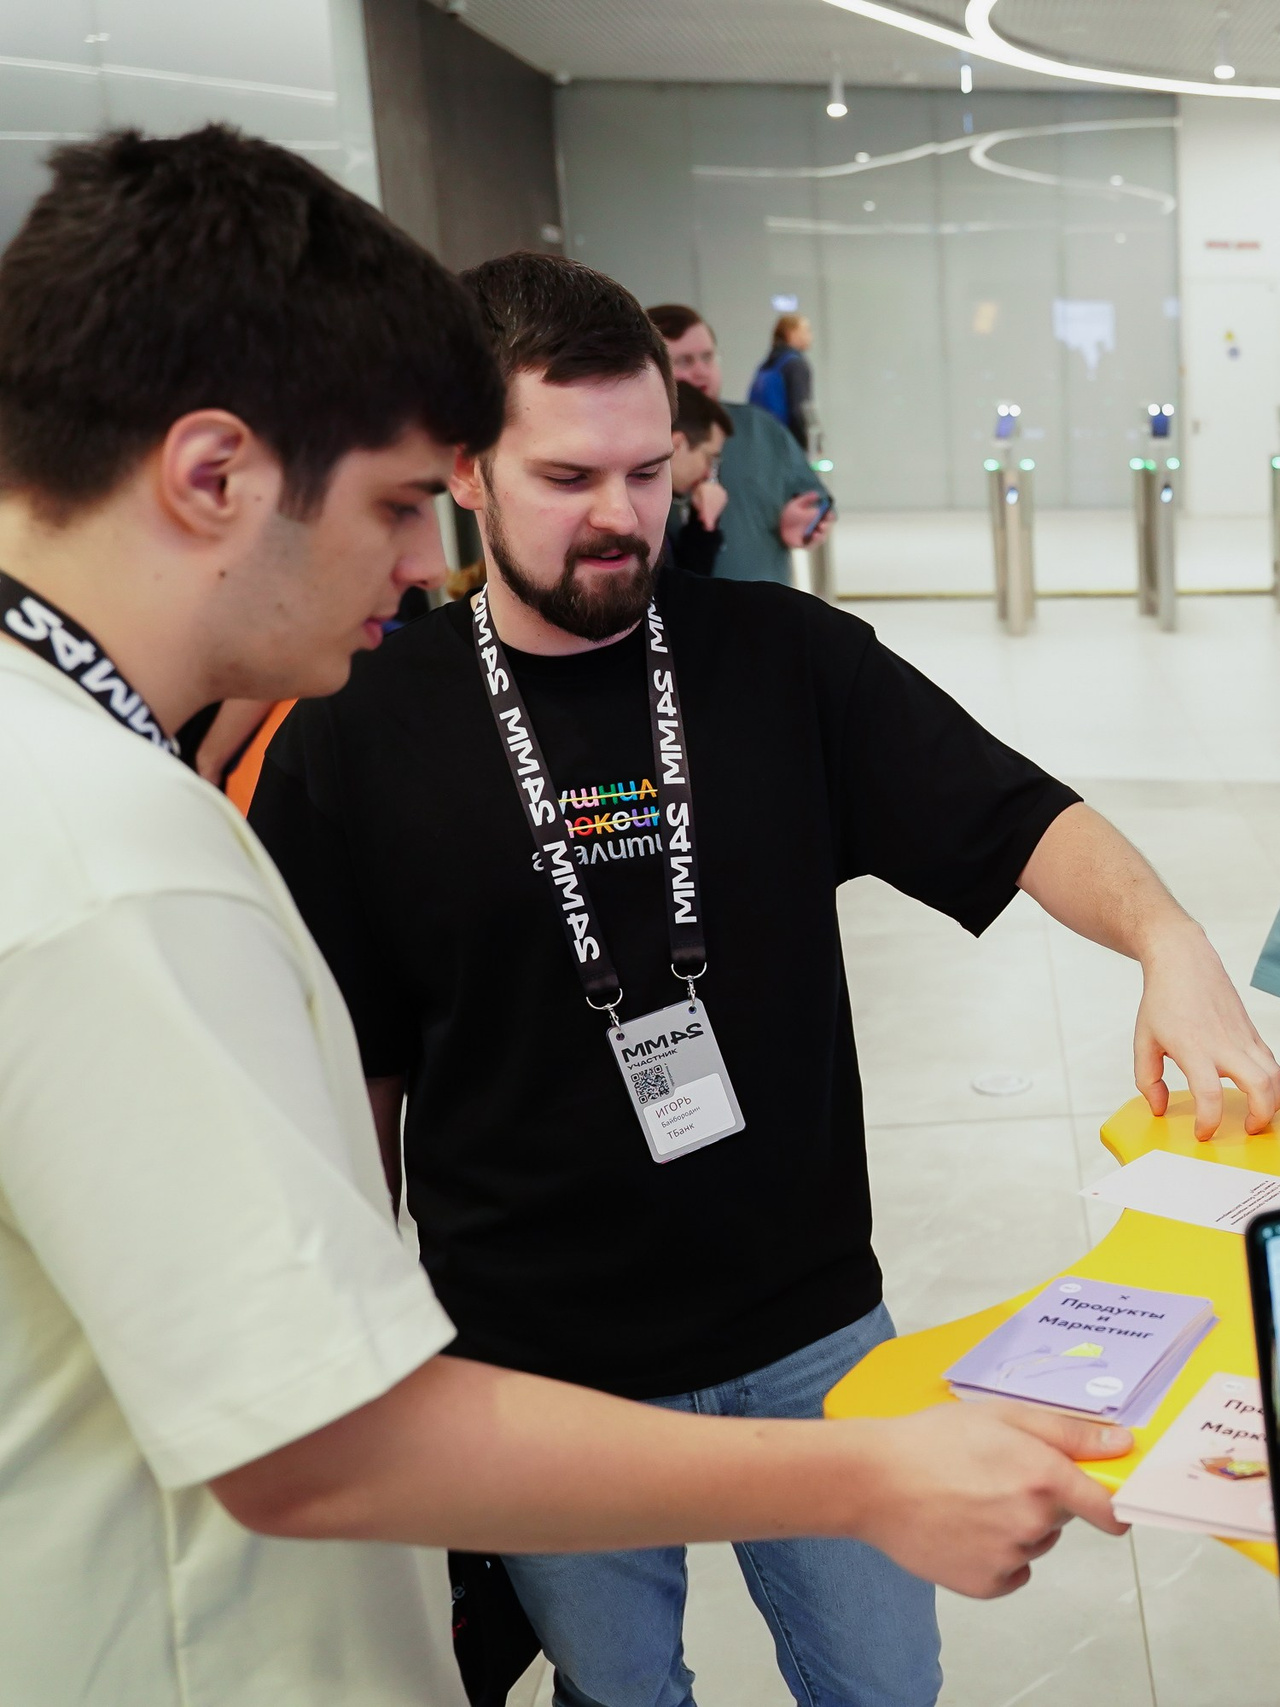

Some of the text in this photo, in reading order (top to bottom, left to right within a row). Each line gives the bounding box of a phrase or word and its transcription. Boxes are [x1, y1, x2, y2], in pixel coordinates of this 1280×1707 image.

[559, 779, 658, 815] ушнил
[627, 1048, 678, 1071] УЧАСТНИК
[655, 1095, 692, 1119] ИГОРЬ
[667, 1123, 695, 1140] ТБанк
[1061, 1298, 1165, 1319] Продукты
[1038, 1315, 1154, 1339] Маркетинг
